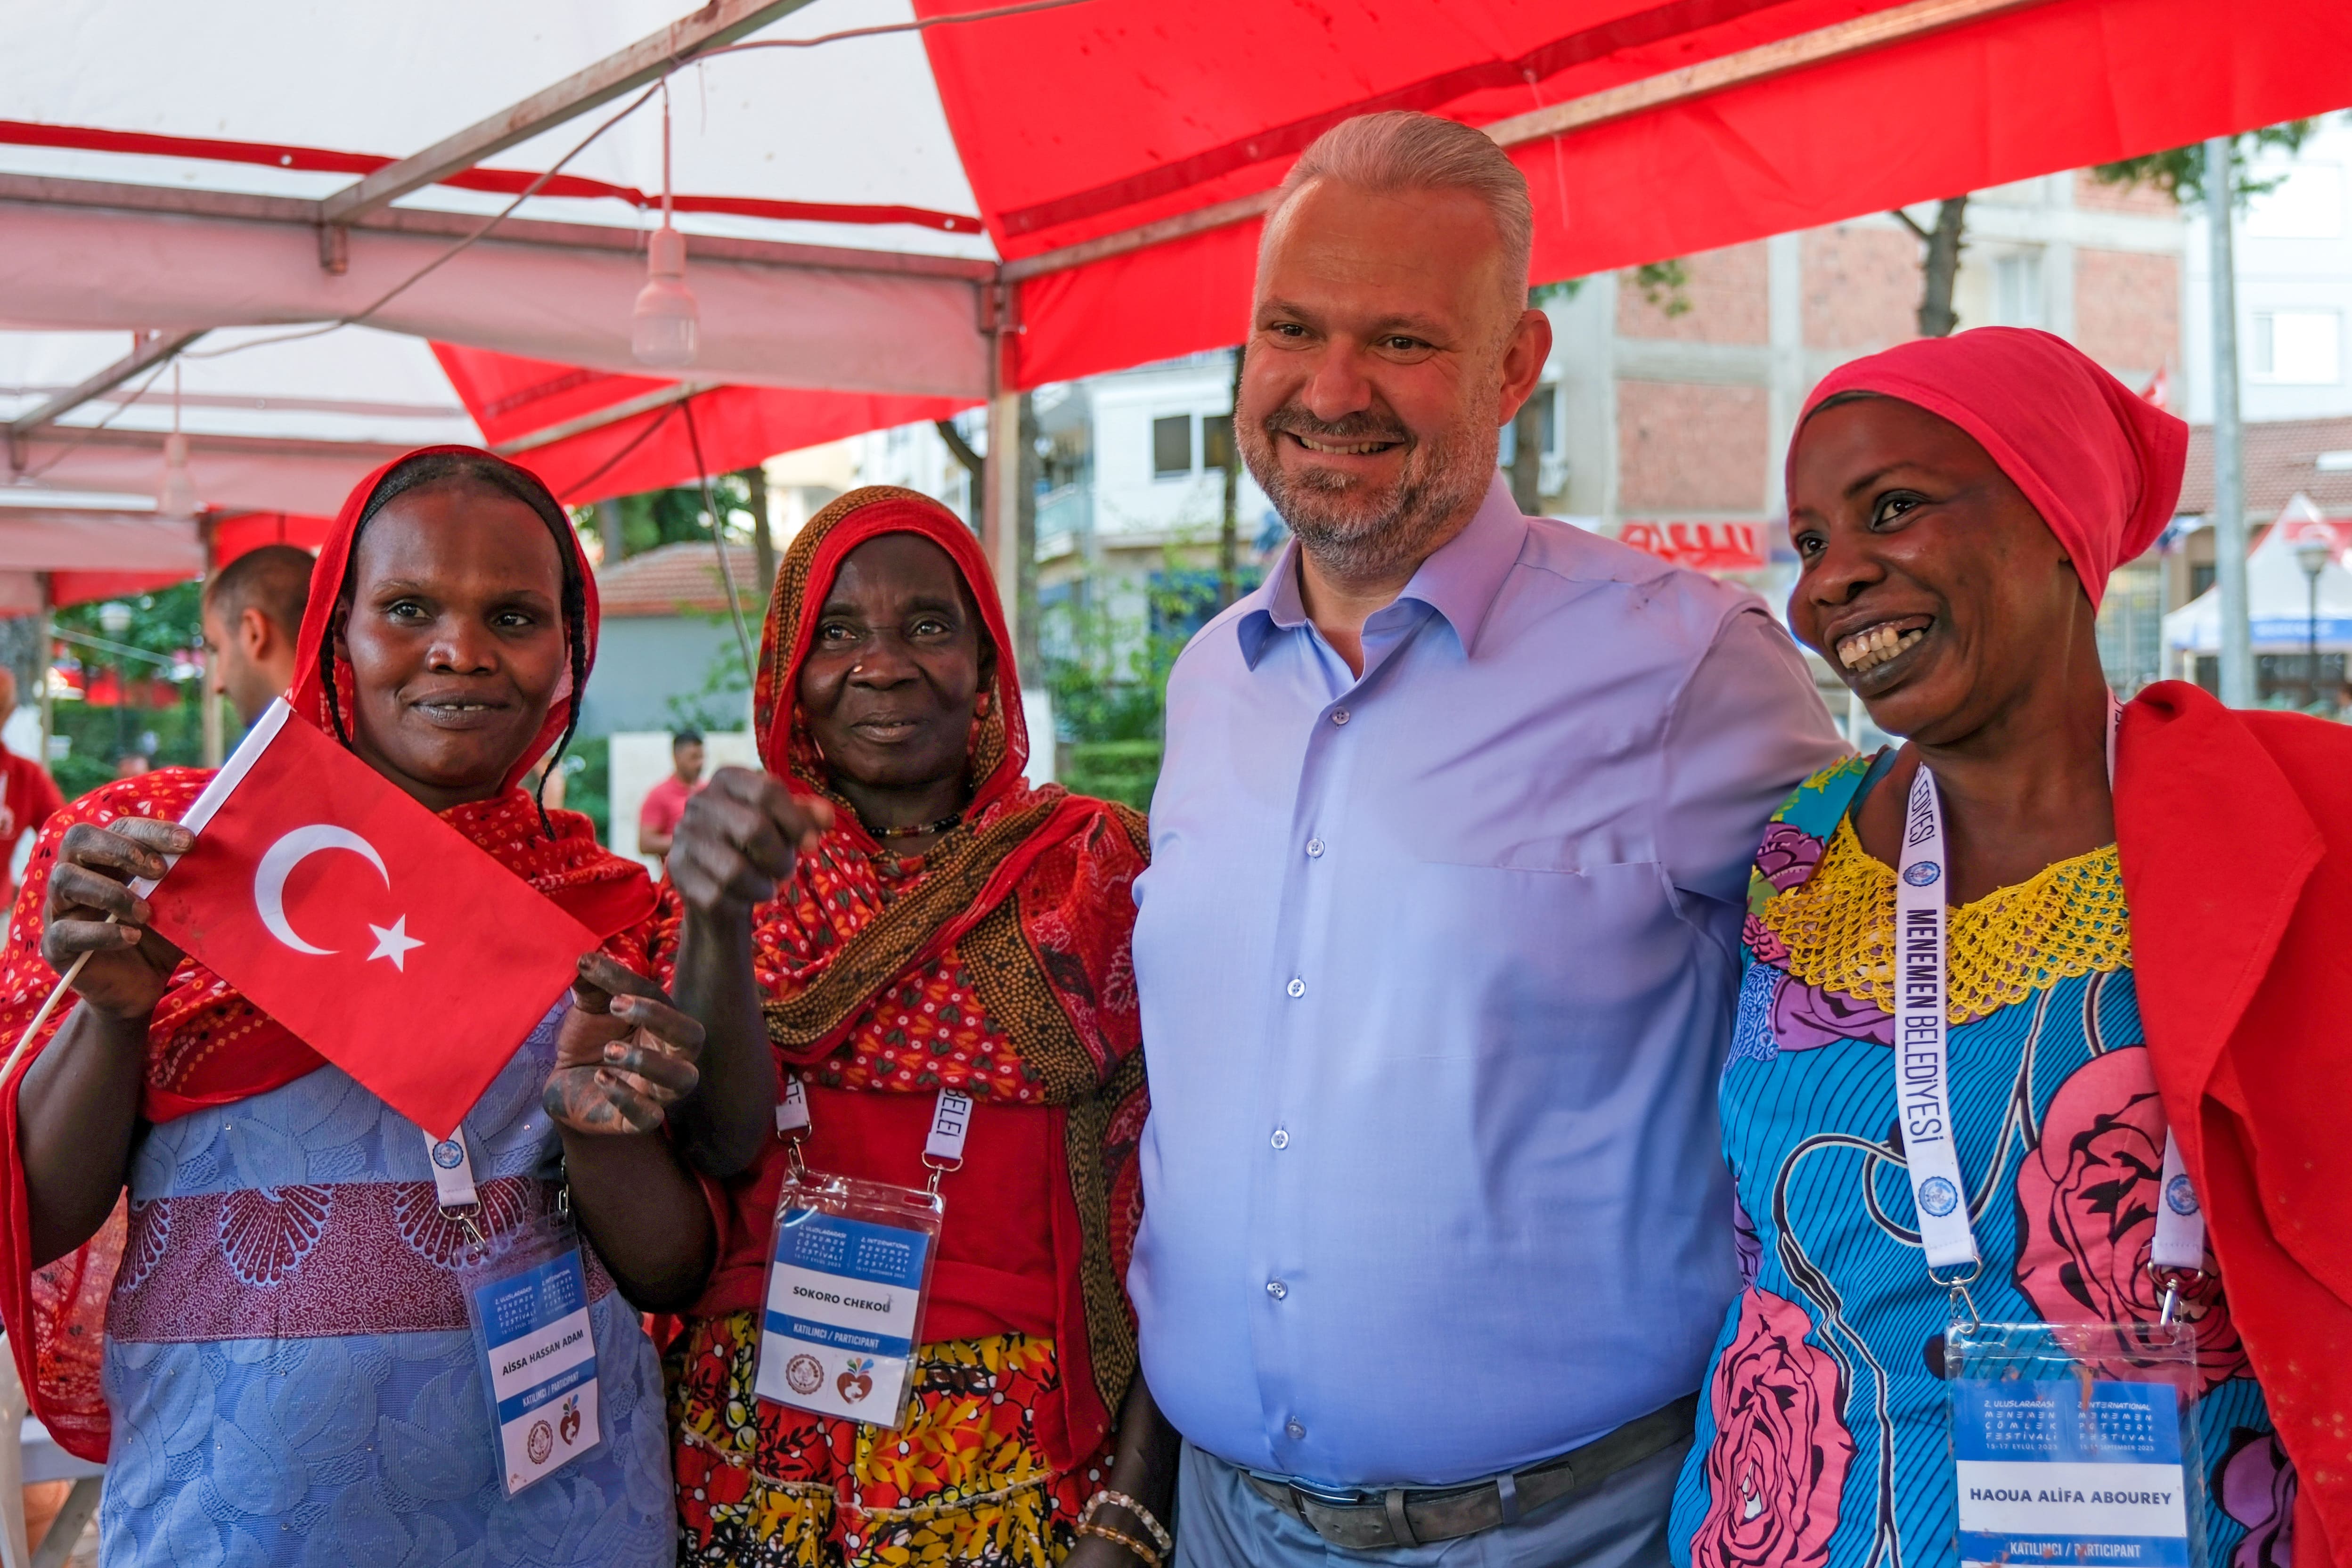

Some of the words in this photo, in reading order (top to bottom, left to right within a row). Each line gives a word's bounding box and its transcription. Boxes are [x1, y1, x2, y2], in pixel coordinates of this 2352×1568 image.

[1906, 909, 1937, 1009] MENEMEN
[792, 1286, 840, 1304] SOKORO
[793, 1323, 827, 1339] KATILIMCI
[834, 1331, 879, 1348] PARTICIPANT
[502, 1357, 528, 1376] AİSSA
[530, 1340, 561, 1363] HASSAN
[563, 1329, 584, 1348] ADAM
[522, 1388, 547, 1408] KATILIMCI
[551, 1371, 579, 1394] PARTICIPANT
[2078, 1413, 2152, 1421] MENEMEN
[1985, 1421, 2056, 1429] ÇÖMLEK
[2079, 1423, 2153, 1431] POTTERY
[1986, 1431, 2057, 1440] FESTİVALİ
[2080, 1434, 2153, 1442] FESTIVAL
[1970, 1488, 2032, 1502] HAOUA
[2037, 1487, 2084, 1503] ALİFA
[2090, 1491, 2172, 1504] ABOUREY
[2066, 1543, 2071, 1556] /
